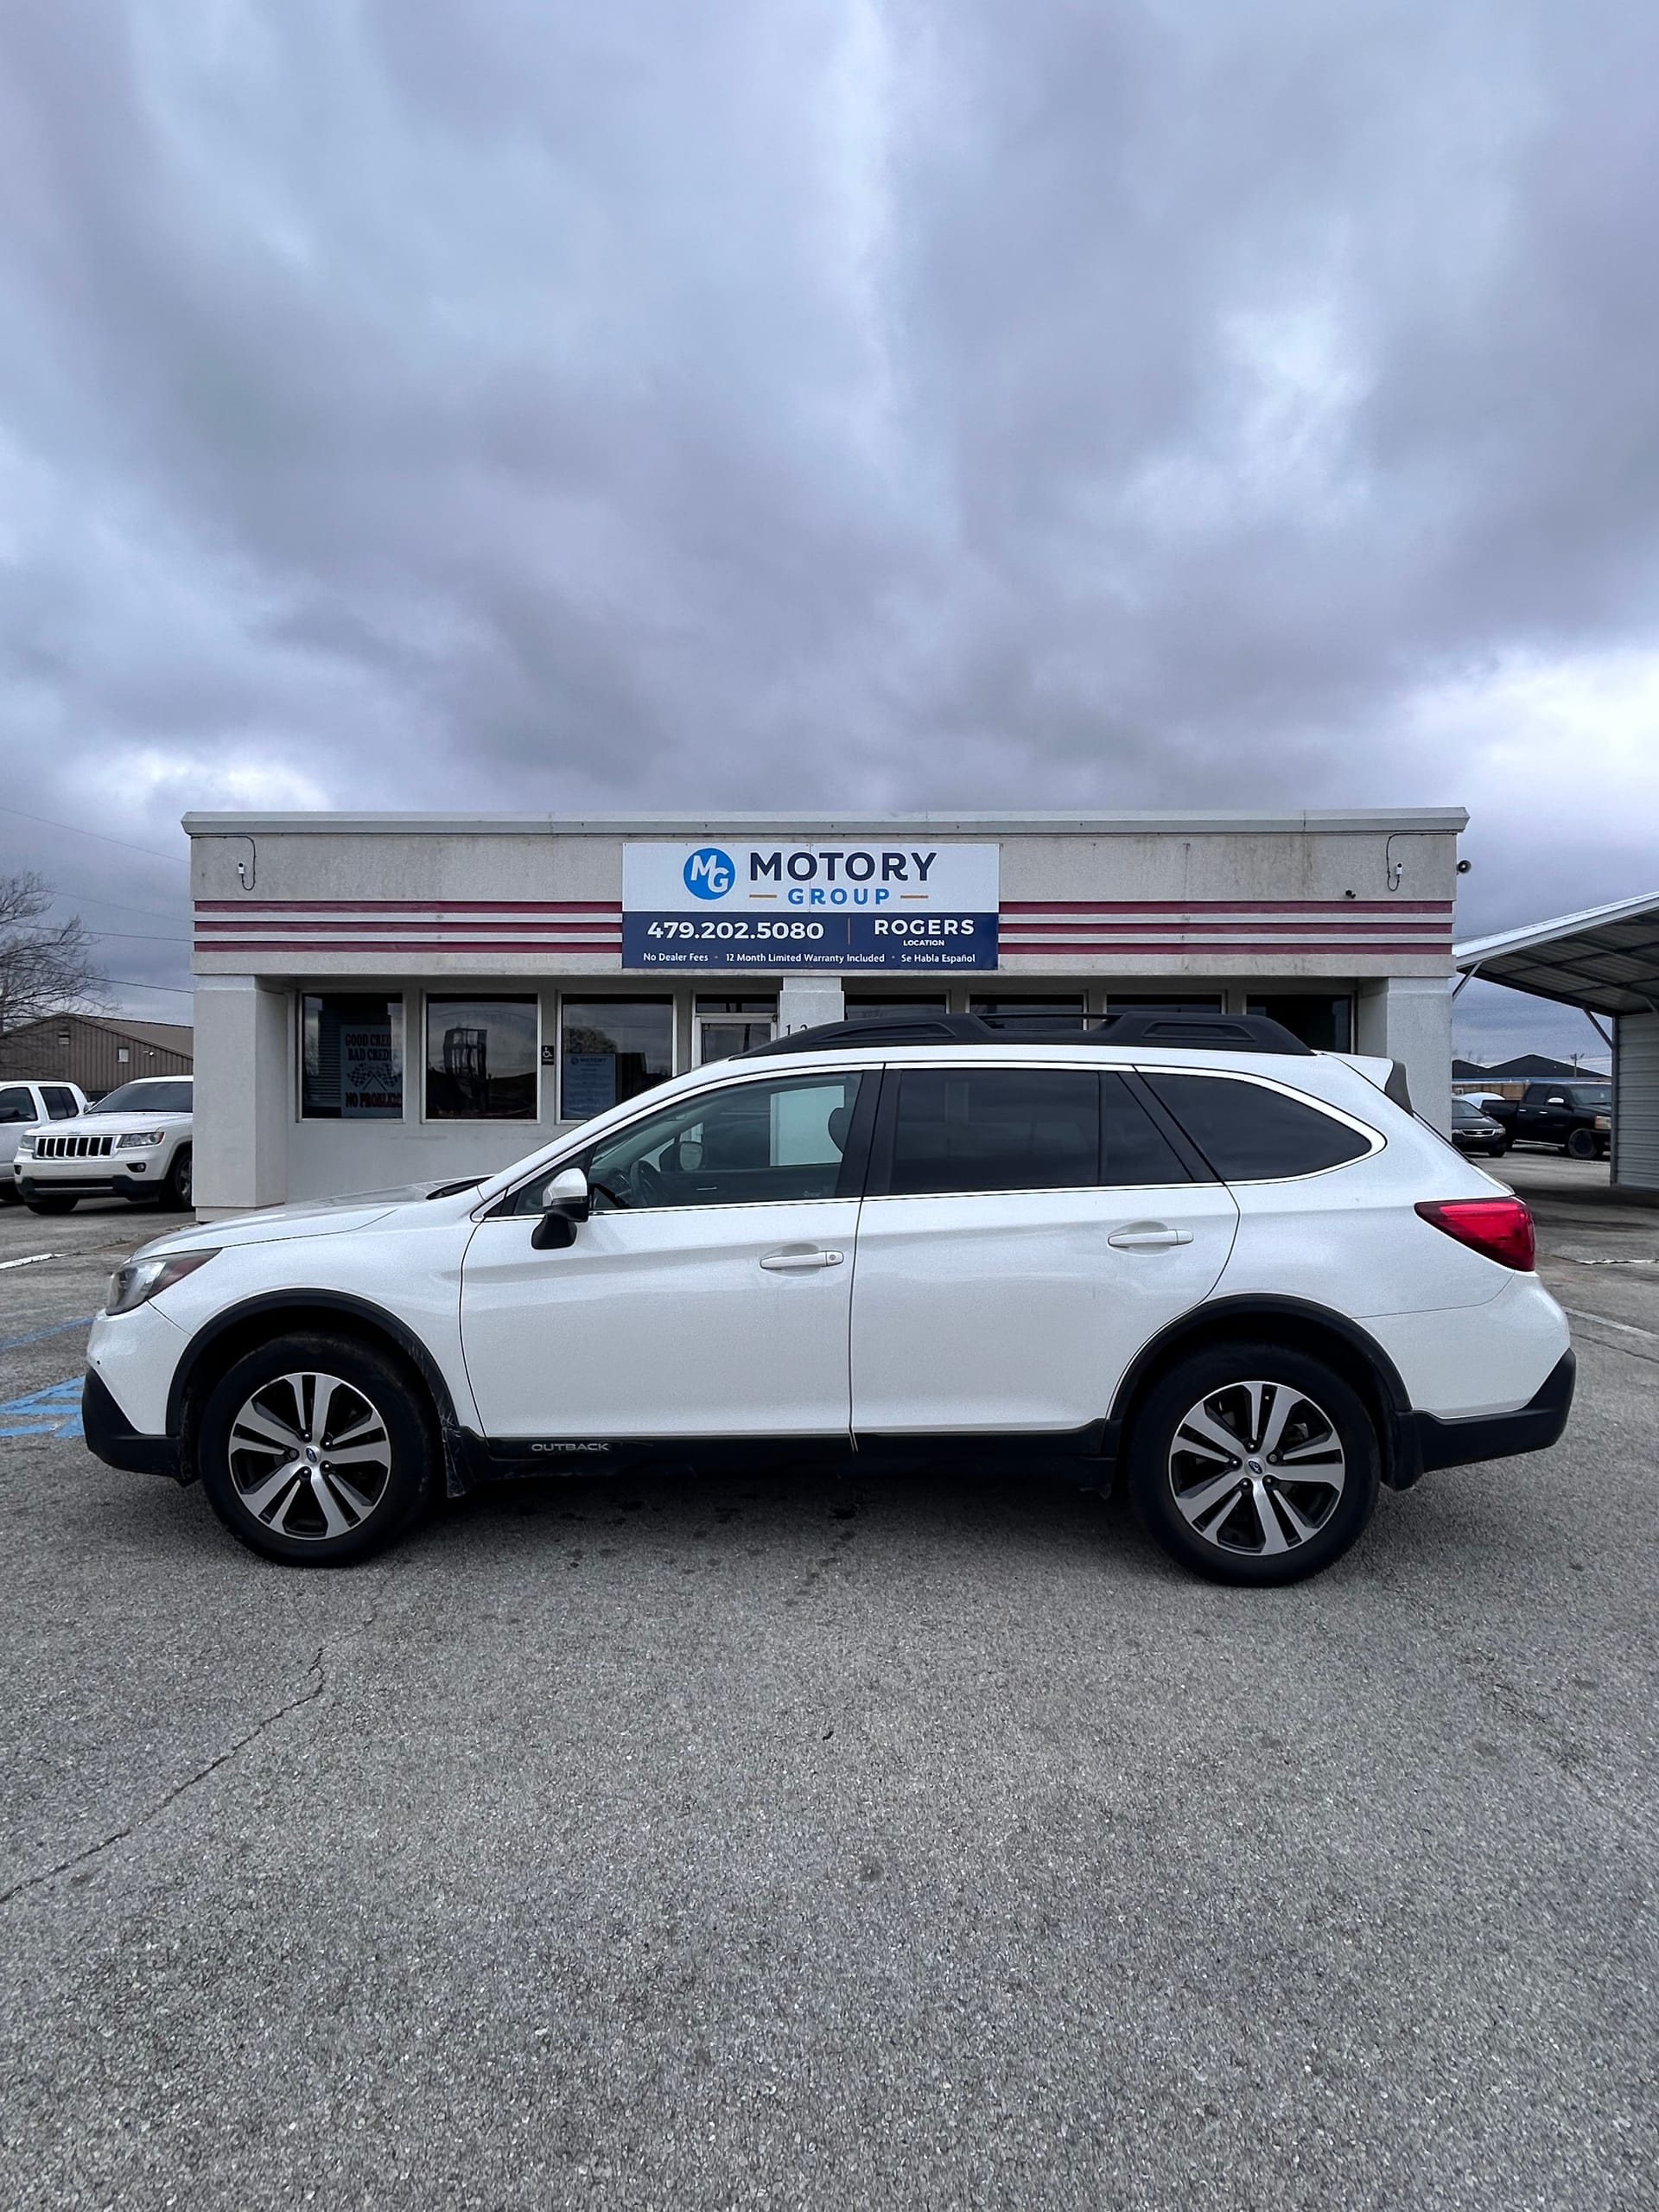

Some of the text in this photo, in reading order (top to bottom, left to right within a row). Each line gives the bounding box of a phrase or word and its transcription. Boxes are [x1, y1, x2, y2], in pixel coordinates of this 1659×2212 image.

[690, 855, 730, 893] MG
[750, 852, 938, 881] MOTORY
[787, 888, 890, 906] GROUP
[647, 921, 824, 940] 479.202.5080
[874, 919, 975, 936] ROGERS
[643, 952, 976, 965] No Dealer Fees 12 Month Limited Warranty Included Se Habla Español
[346, 1033, 369, 1047] GOOD
[348, 1048, 365, 1061] BAD
[346, 1092, 359, 1109] NO
[531, 1442, 609, 1452] OUTBACK
